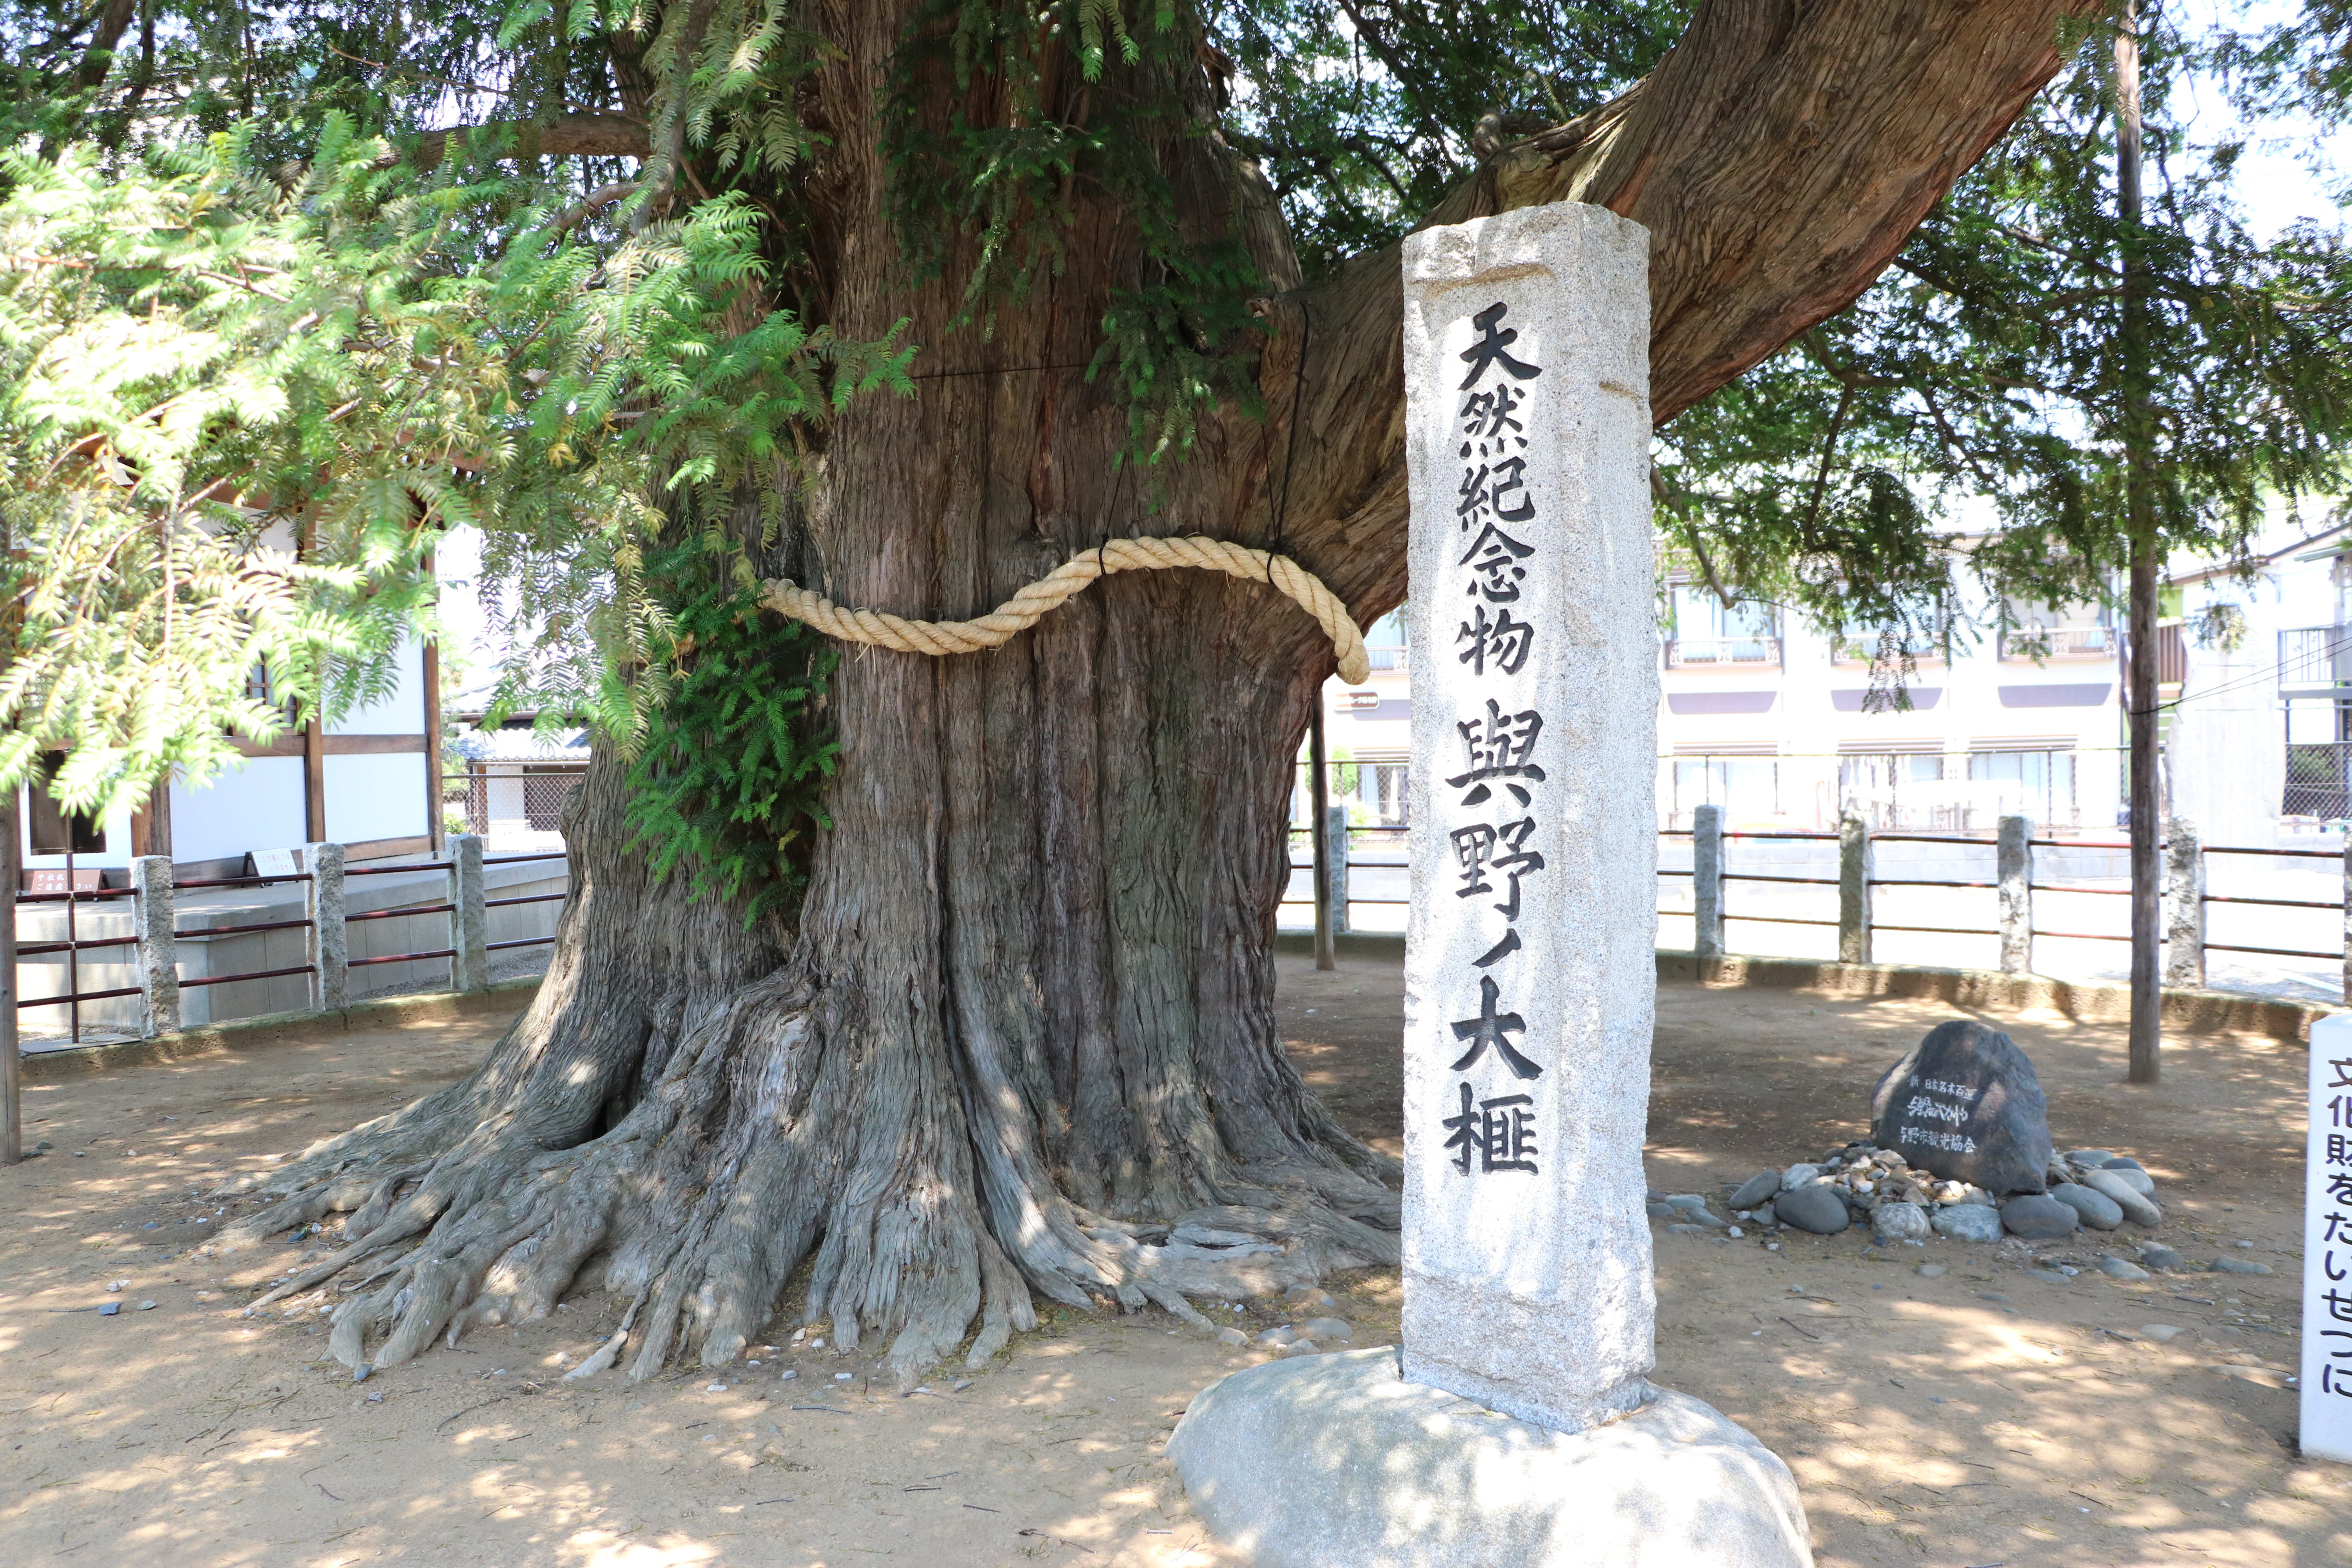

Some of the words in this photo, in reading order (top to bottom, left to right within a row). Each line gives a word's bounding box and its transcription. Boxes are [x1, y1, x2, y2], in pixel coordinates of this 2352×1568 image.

[1454, 301, 1542, 676] 天然紀念物
[258, 853, 290, 863] ここで遊んでは
[270, 862, 293, 871] いけません
[37, 882, 92, 891] ご遠慮さい
[2320, 1057, 2352, 1398] 文化財をたいせつに
